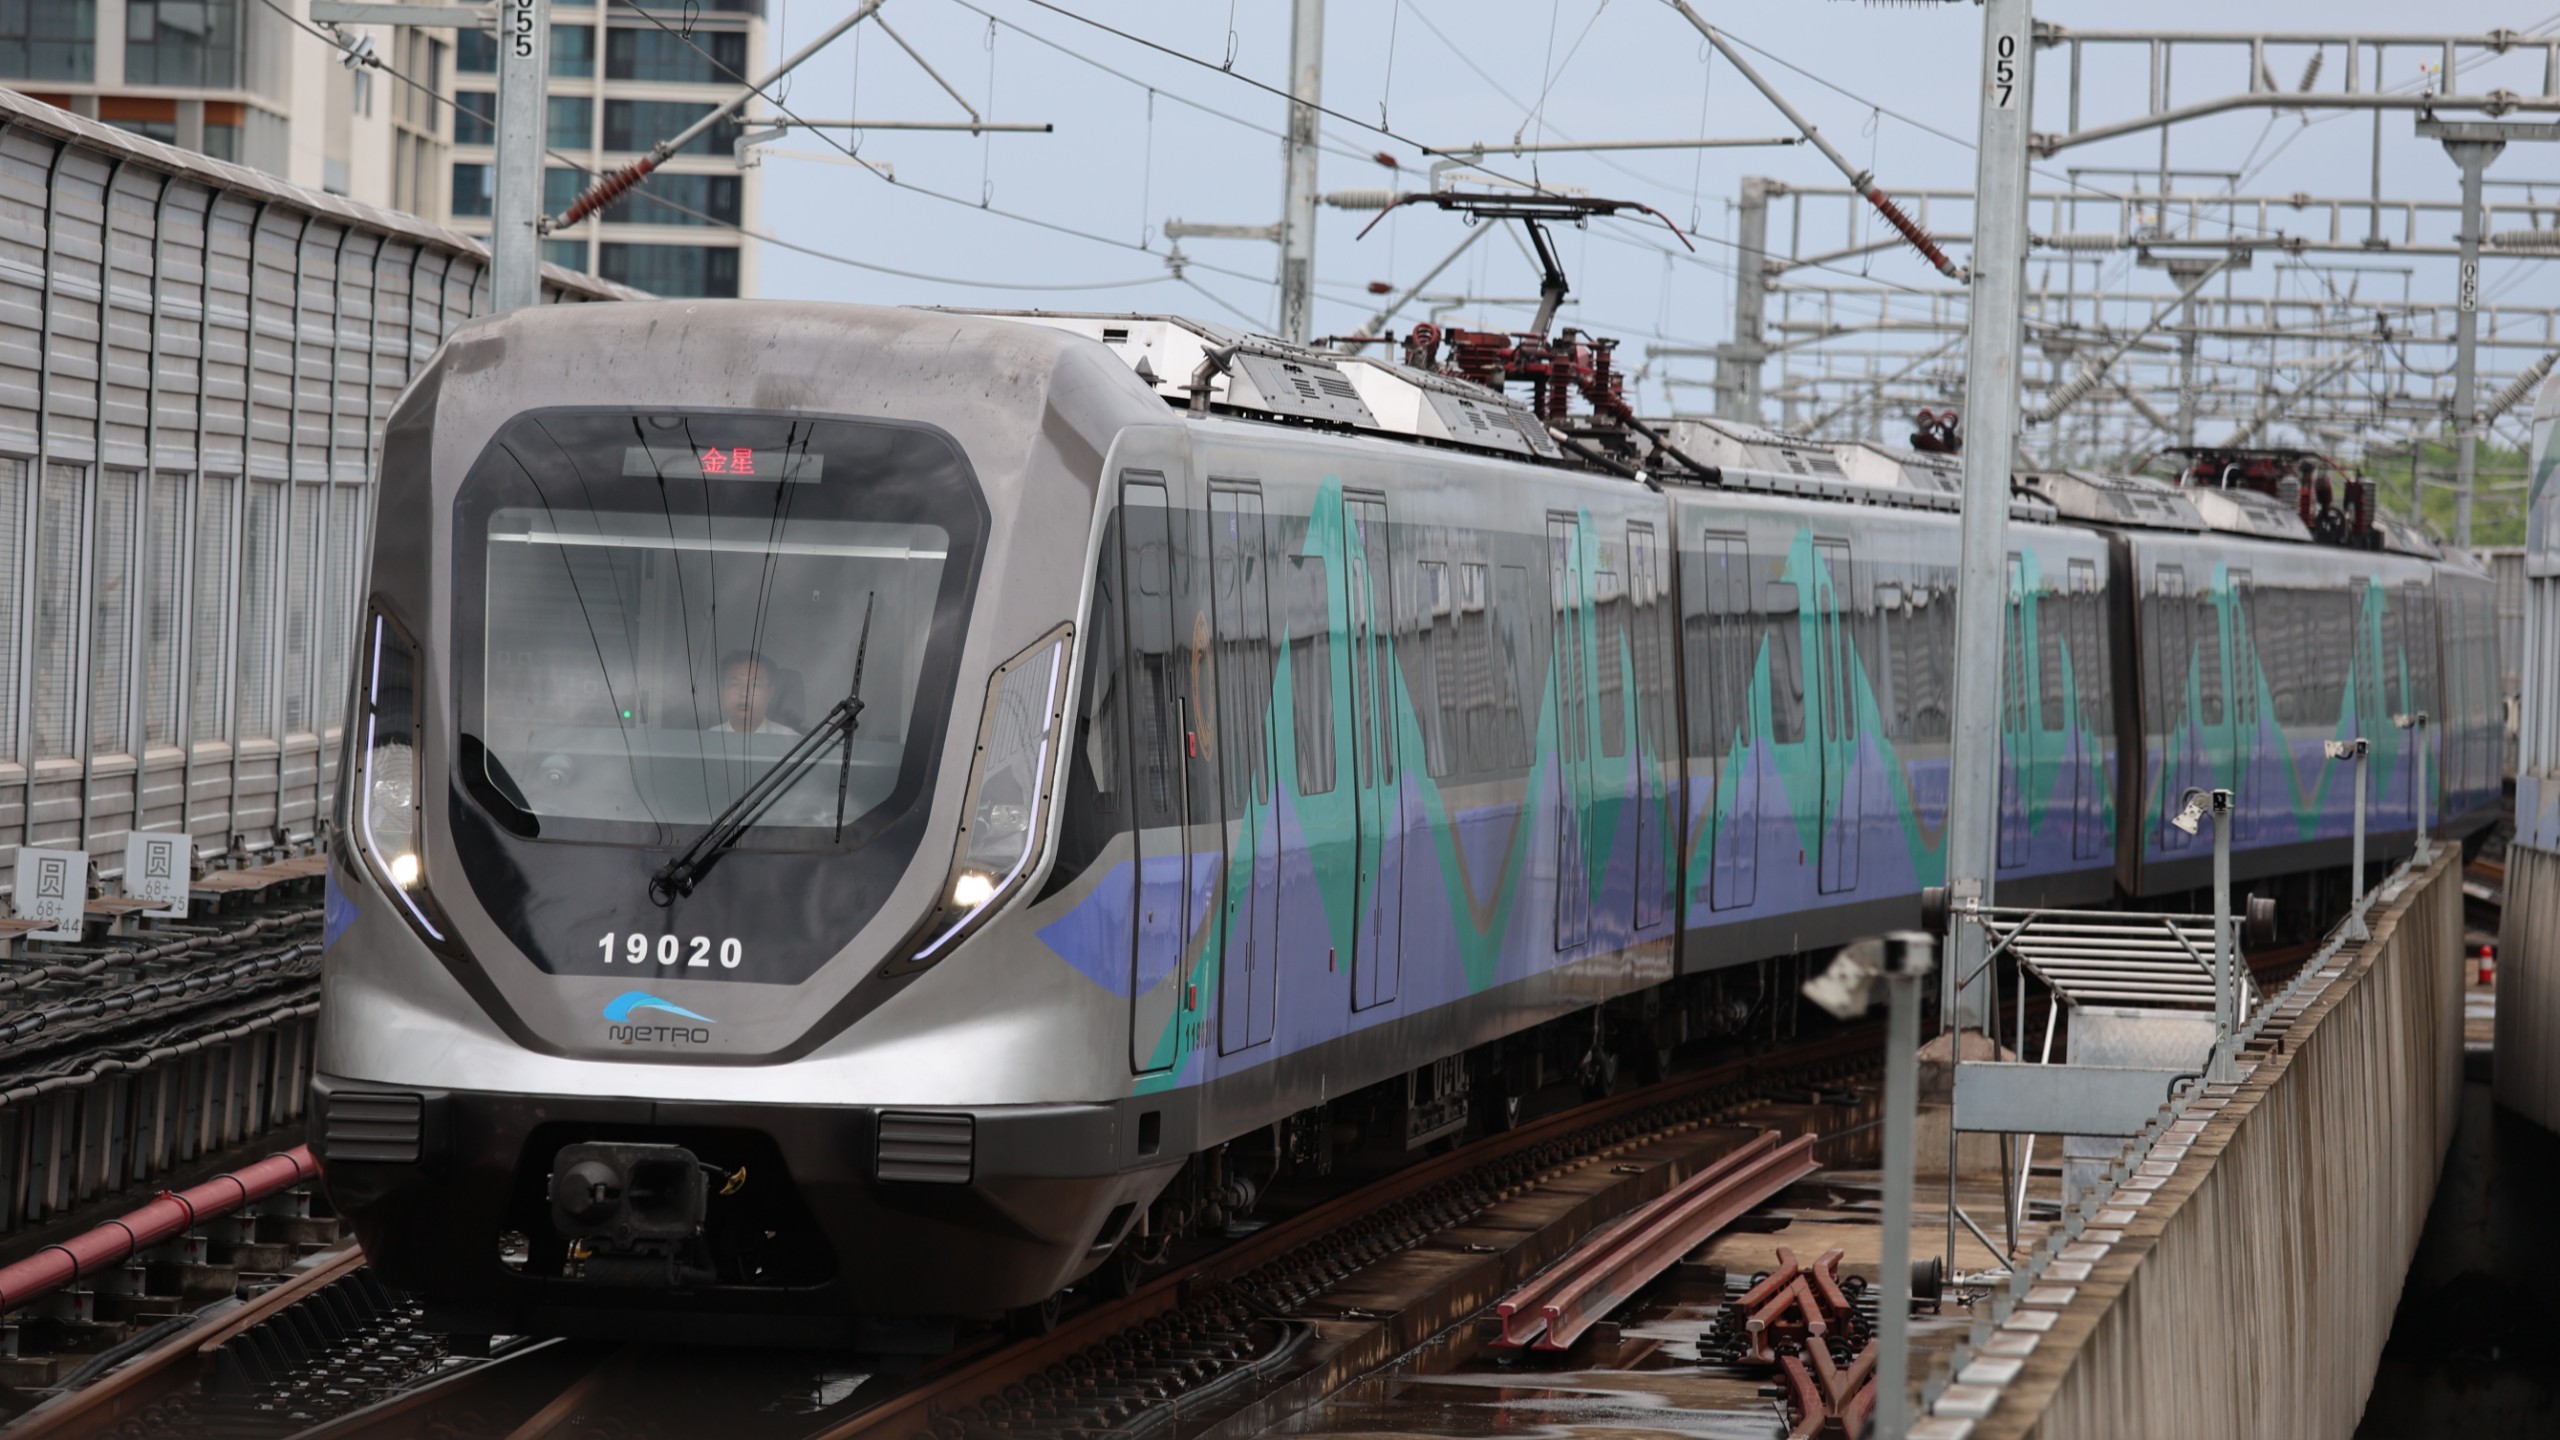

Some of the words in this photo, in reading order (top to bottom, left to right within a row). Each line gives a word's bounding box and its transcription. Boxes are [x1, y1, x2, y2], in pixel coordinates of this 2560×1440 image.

[1996, 35, 2015, 108] 057
[2463, 263, 2475, 311] 065
[701, 448, 755, 475] 金星
[36, 857, 67, 900] 圆
[145, 840, 173, 880] 圆
[145, 880, 170, 895] 68+
[36, 900, 64, 917] 68+
[598, 932, 743, 969] 19020
